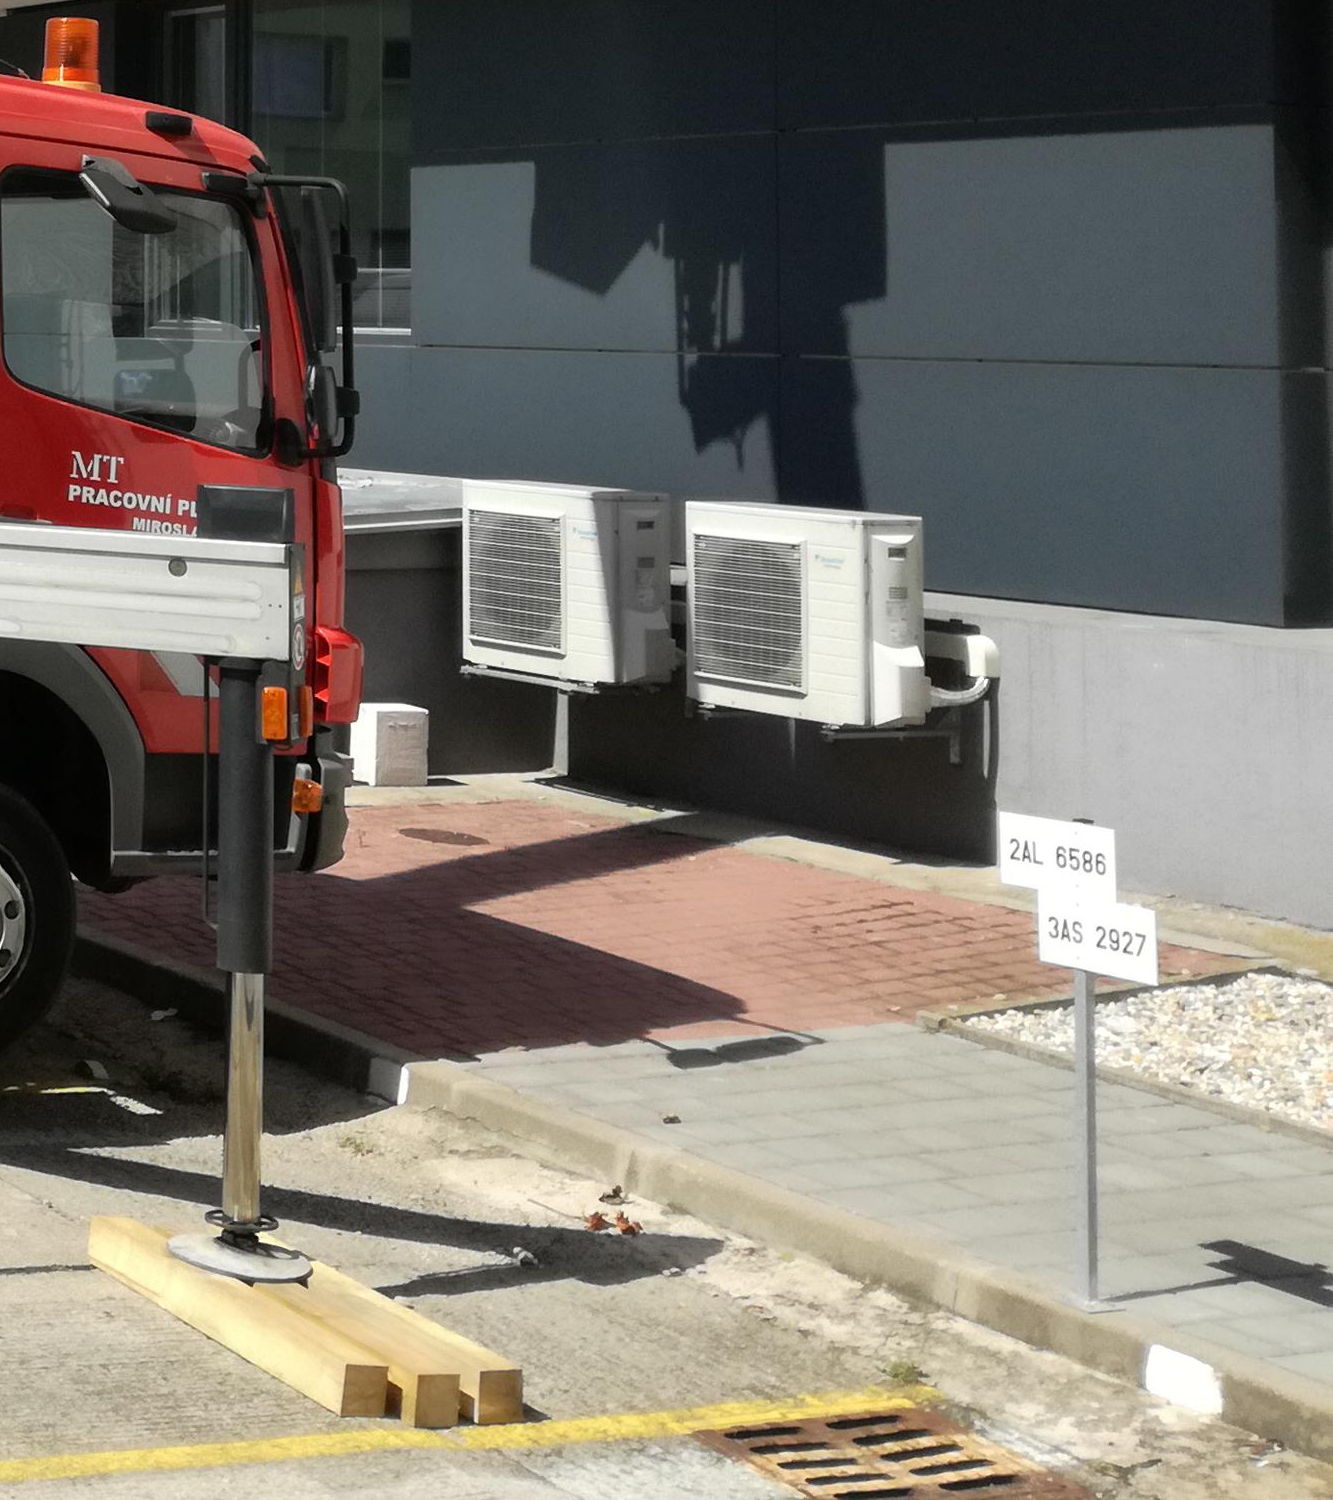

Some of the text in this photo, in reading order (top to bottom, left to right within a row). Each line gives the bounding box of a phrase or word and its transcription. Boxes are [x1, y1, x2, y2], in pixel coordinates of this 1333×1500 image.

[70, 450, 125, 484] MT
[68, 483, 173, 515] PRACOVNÍ
[1009, 838, 1107, 875] 2AL 6586
[1047, 916, 1147, 957] 3AS 2927
